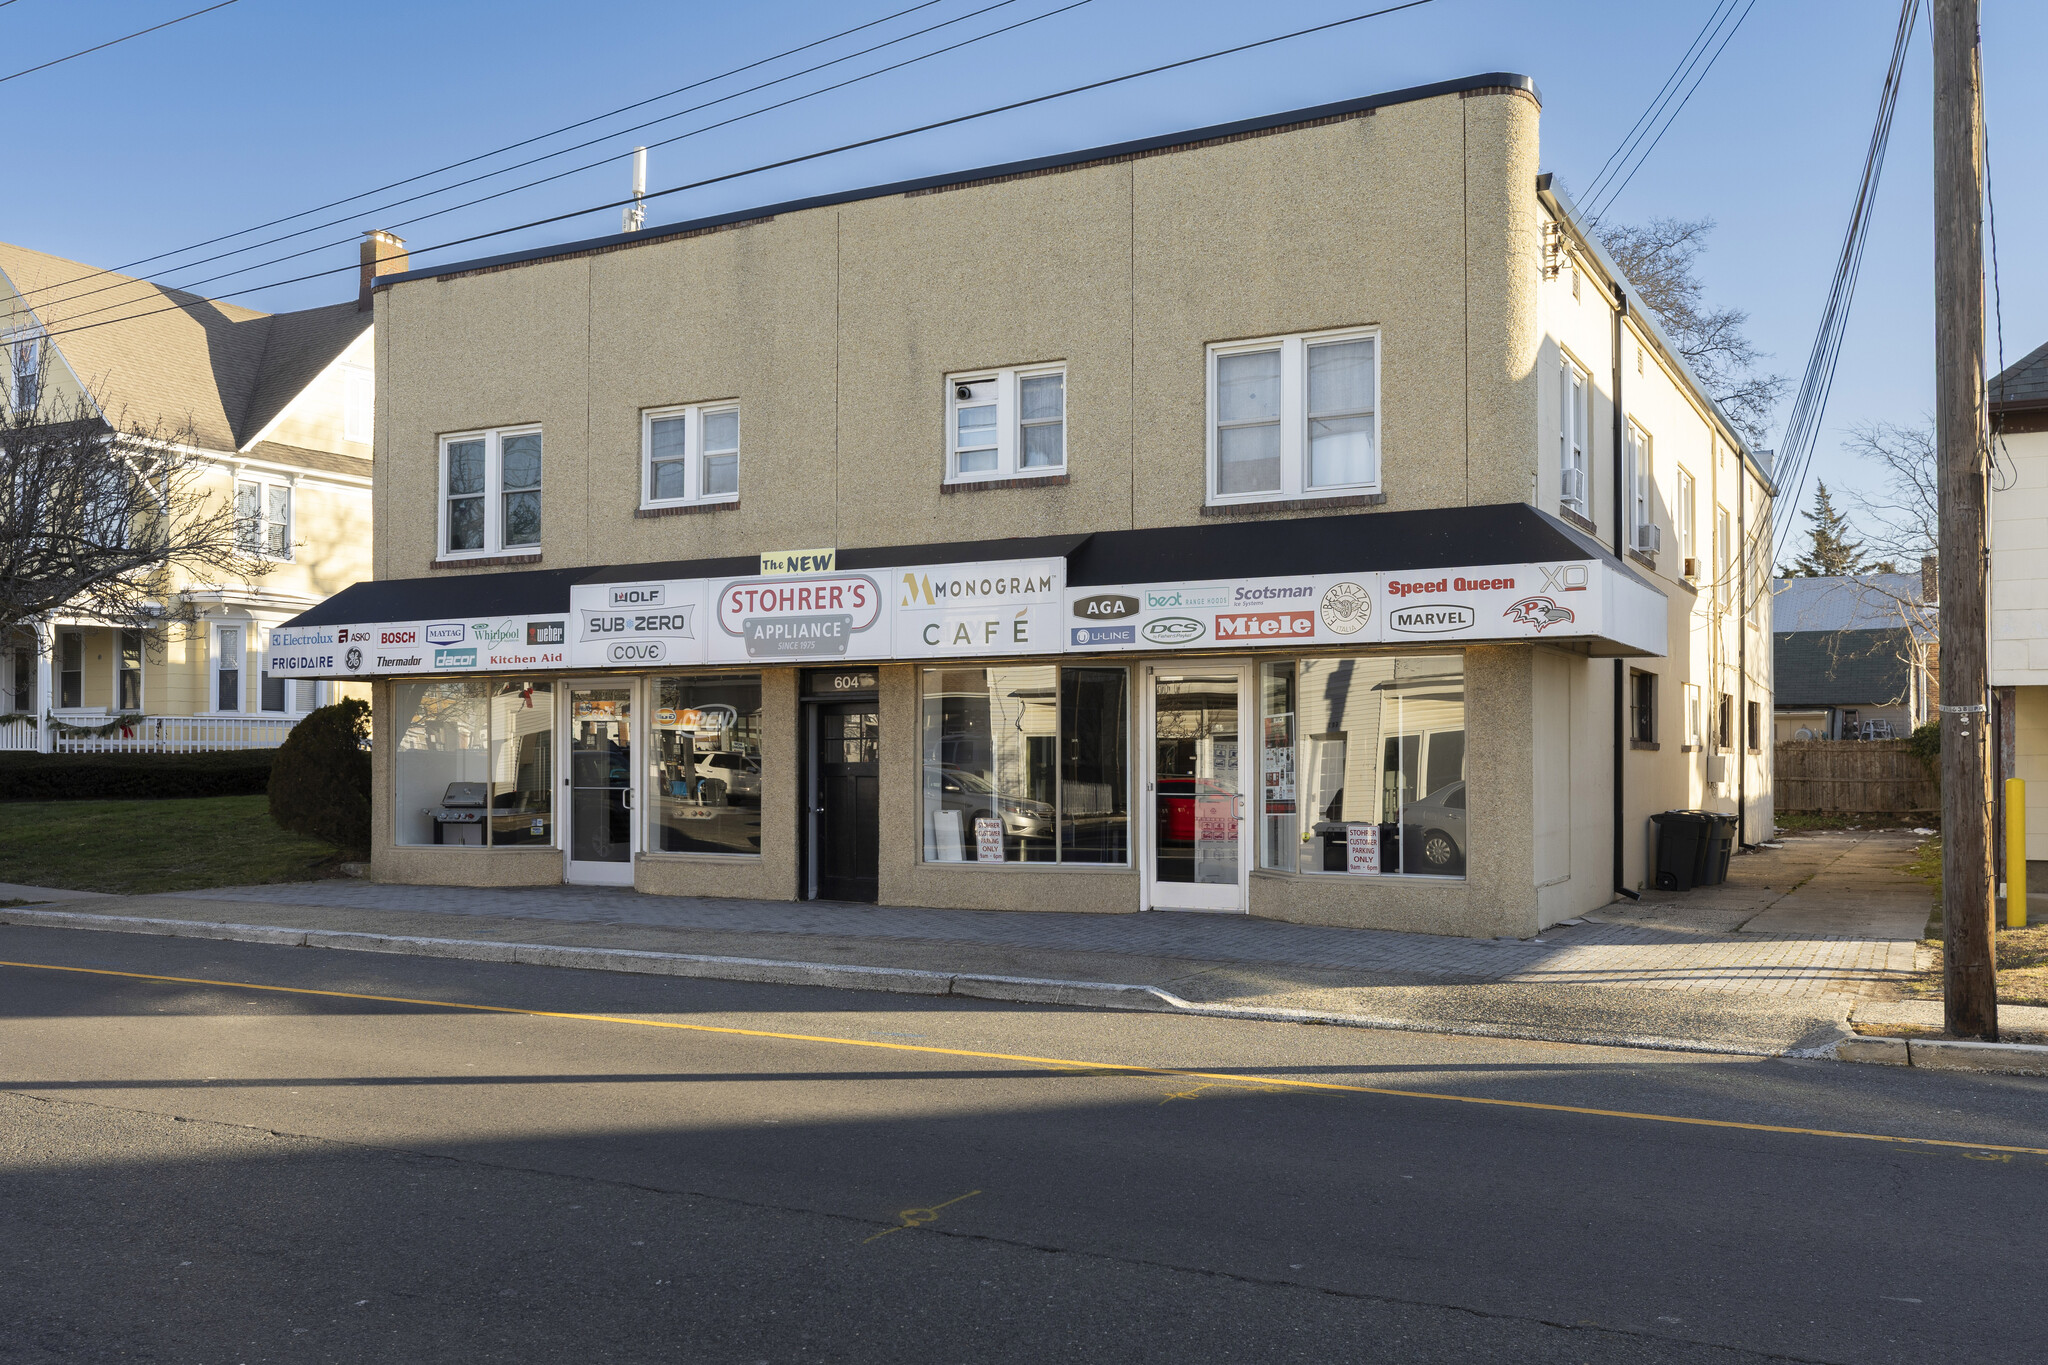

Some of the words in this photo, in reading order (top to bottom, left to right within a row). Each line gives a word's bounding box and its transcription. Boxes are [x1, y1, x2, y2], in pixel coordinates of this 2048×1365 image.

[762, 560, 784, 570] The
[787, 553, 833, 573] NEW
[1539, 565, 1588, 593] XO
[935, 575, 1051, 598] MONOGRAM
[1235, 586, 1313, 600] Scotsman
[1388, 578, 1447, 597] Speed
[1453, 577, 1515, 592] Queen
[614, 590, 659, 603] WOLF
[731, 584, 866, 613] STOHRER'S
[1148, 592, 1182, 607] best
[1087, 600, 1126, 615] AGA
[1323, 584, 1370, 626] BERTAZZONI
[590, 617, 625, 632] SUB
[634, 615, 684, 631] ZERO
[923, 606, 1029, 646] CAFÉ
[1218, 615, 1312, 636] Miele
[1398, 612, 1466, 626] MARVEL
[429, 629, 461, 638] MAYTAG
[475, 628, 519, 642] Whirlpool
[754, 622, 841, 640] APPLIANCE
[1150, 623, 1198, 634] DCS
[1336, 625, 1356, 633] ITALIA
[283, 632, 333, 646] Electrolux
[351, 632, 371, 642] ASKO
[381, 631, 416, 644] BOSCH
[614, 645, 659, 659] COVE
[778, 641, 798, 650] SINCE
[800, 641, 816, 650] 1975
[272, 656, 333, 669] FRIGIDAIRE
[377, 655, 422, 667] Thermador
[436, 651, 476, 667] dacor
[490, 655, 537, 664] Kitchen
[541, 653, 563, 662] Aid
[834, 676, 859, 688] 604
[682, 711, 731, 731] OPEN
[1353, 855, 1374, 863] ONLY
